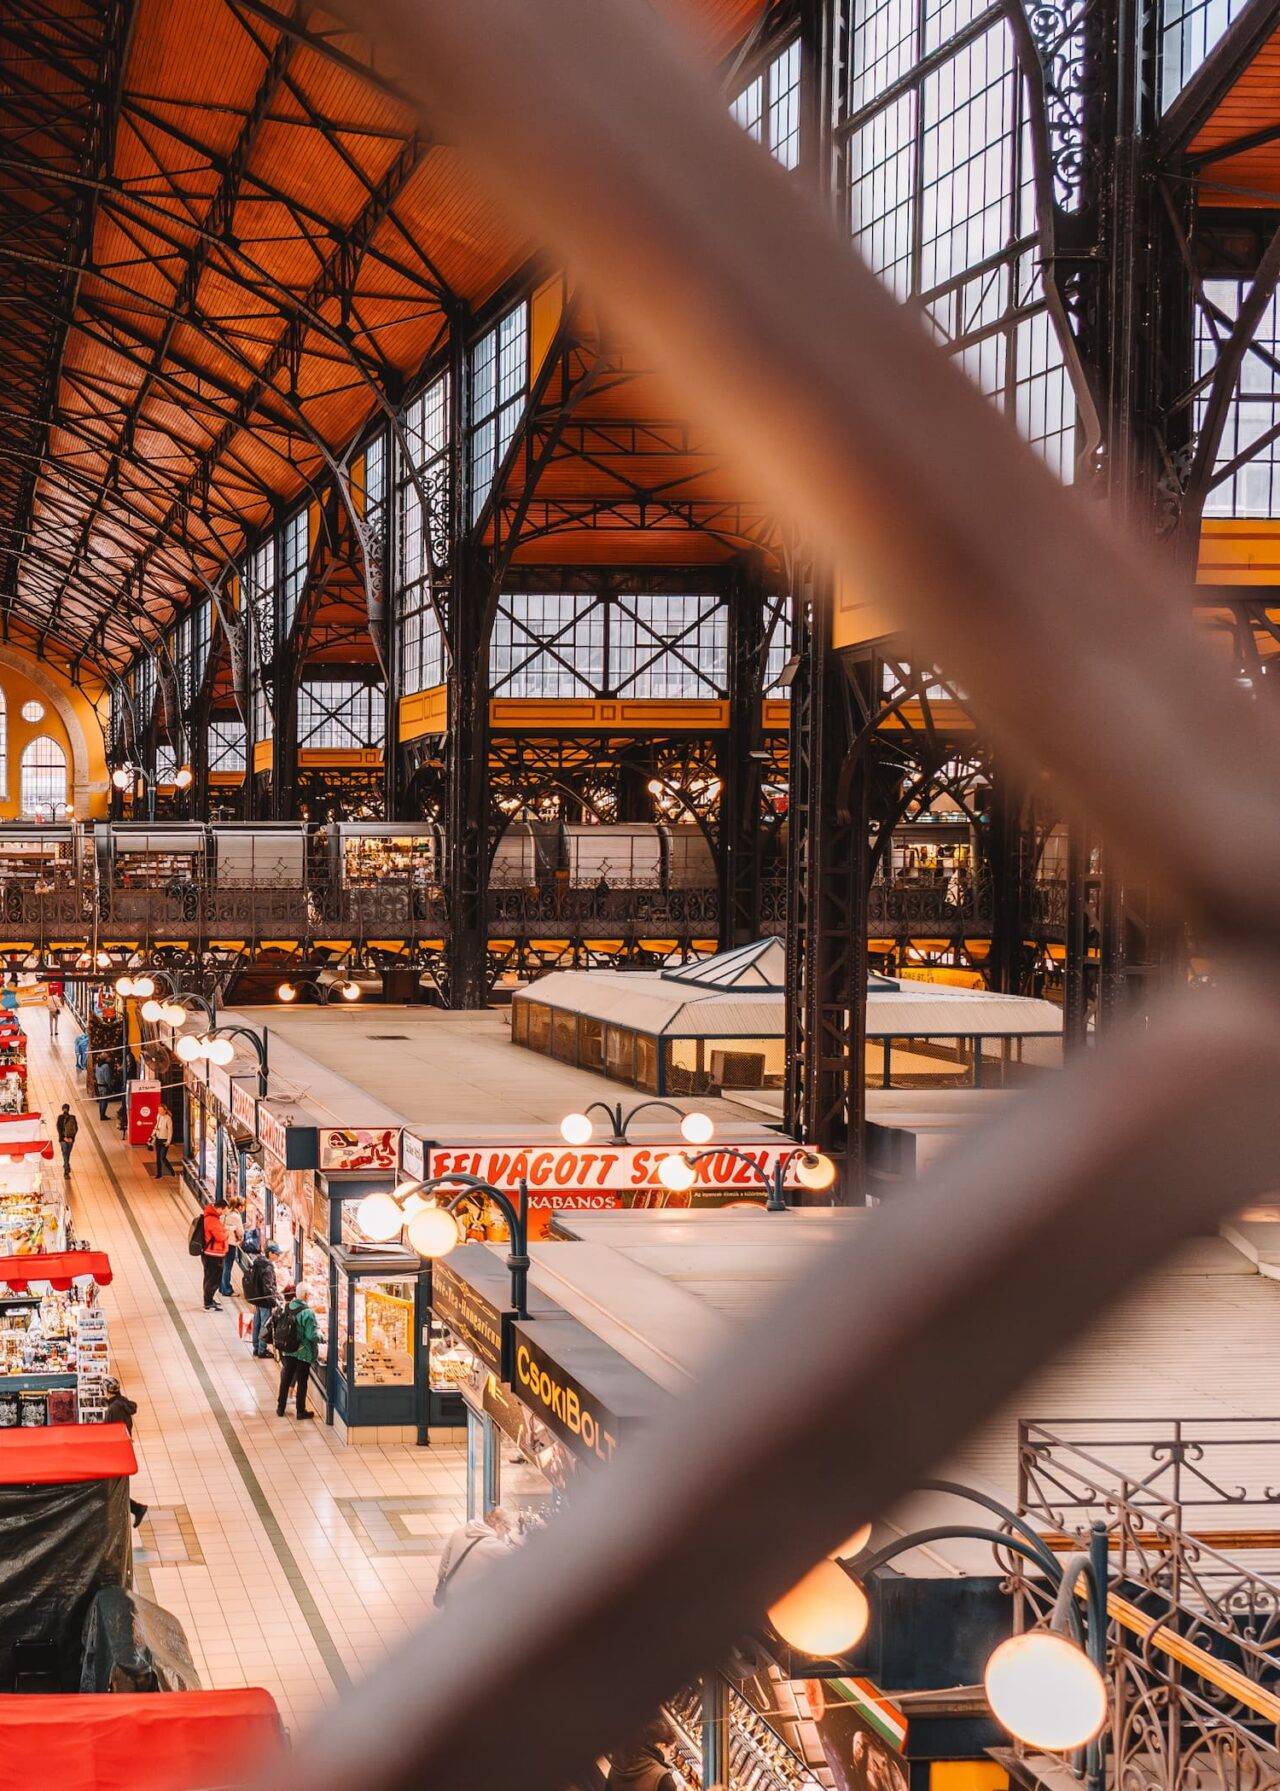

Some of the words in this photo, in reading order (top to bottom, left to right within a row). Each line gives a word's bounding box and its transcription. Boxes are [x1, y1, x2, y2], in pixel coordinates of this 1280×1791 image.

[433, 1149, 619, 1186] FELVÁGOTT
[630, 1148, 805, 1184] SZKÜZLE
[528, 1196, 616, 1209] KABANOS
